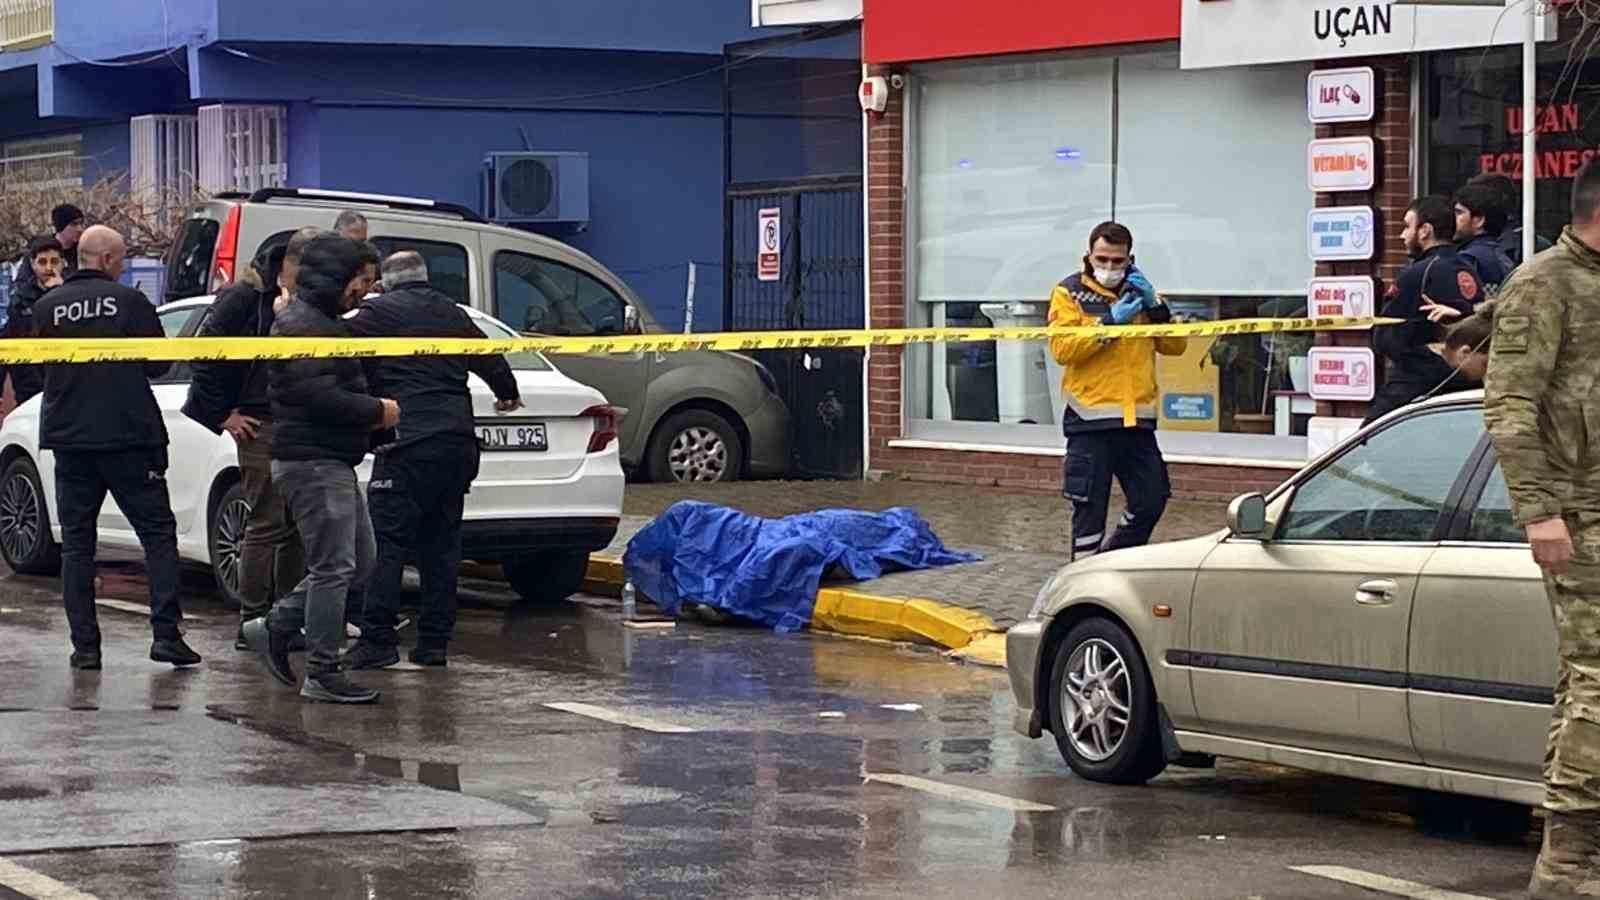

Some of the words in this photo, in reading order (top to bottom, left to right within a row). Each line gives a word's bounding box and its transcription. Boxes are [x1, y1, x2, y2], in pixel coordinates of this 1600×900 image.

[1314, 4, 1391, 48] UÇAN
[1480, 149, 1600, 179] ECZNES
[54, 297, 117, 326] POLİS
[517, 428, 544, 447] 925
